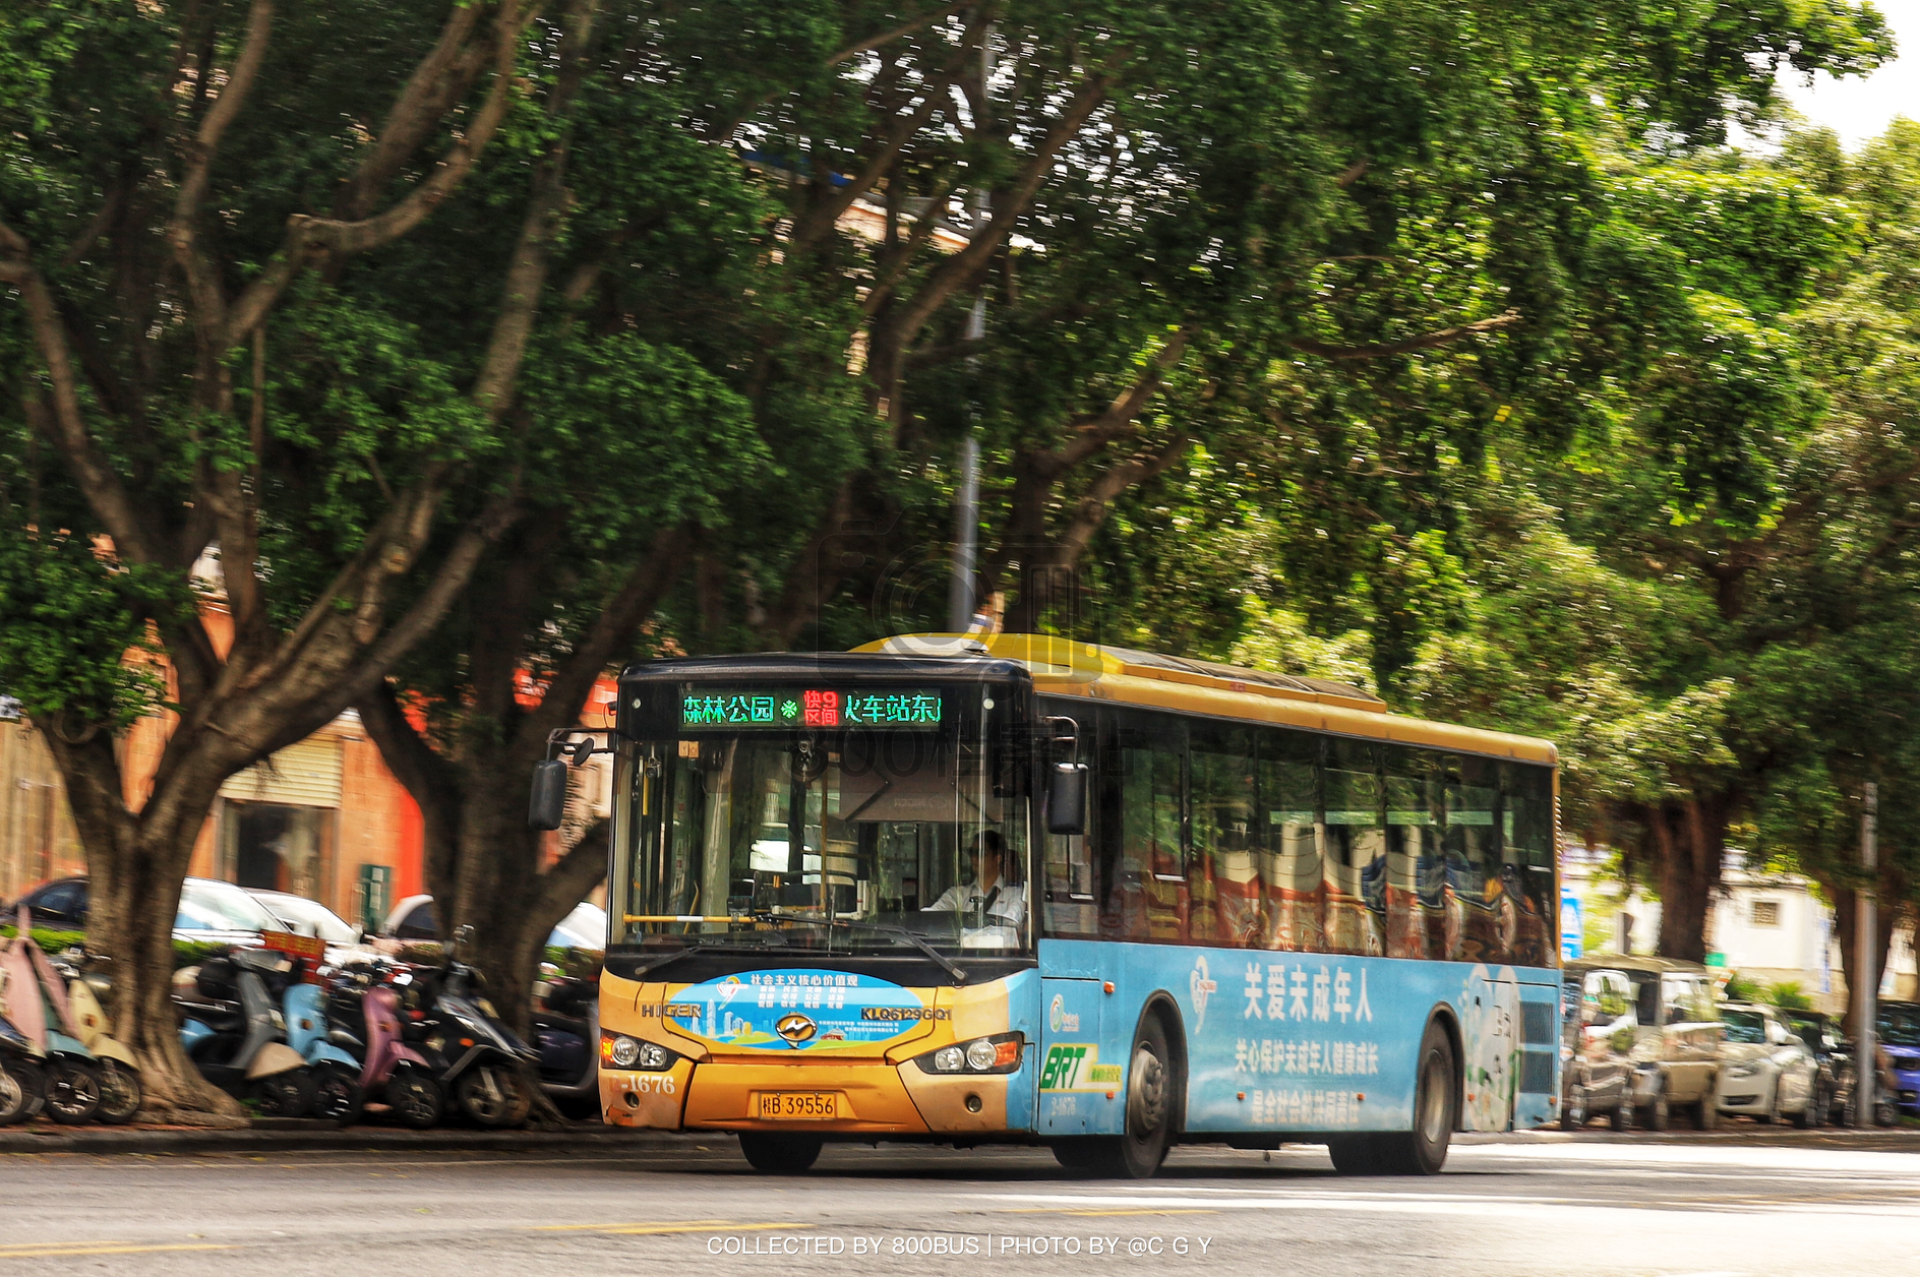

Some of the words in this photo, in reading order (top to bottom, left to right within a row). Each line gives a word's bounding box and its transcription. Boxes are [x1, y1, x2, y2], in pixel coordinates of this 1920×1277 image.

[683, 695, 774, 723] 森林公园
[804, 690, 838, 708] 快9
[845, 694, 941, 723] 火车站东
[804, 709, 838, 726] 区间
[751, 974, 858, 986] 社会主义核心价值观
[1244, 962, 1373, 1024] 关爱未成年人
[642, 1004, 701, 1017] HIGER
[861, 1008, 953, 1021] KLQ6129GQ1
[1235, 1038, 1379, 1075] 关心保护未成年人健康成长
[1041, 1047, 1087, 1089] BRT
[612, 1074, 676, 1094] -1676
